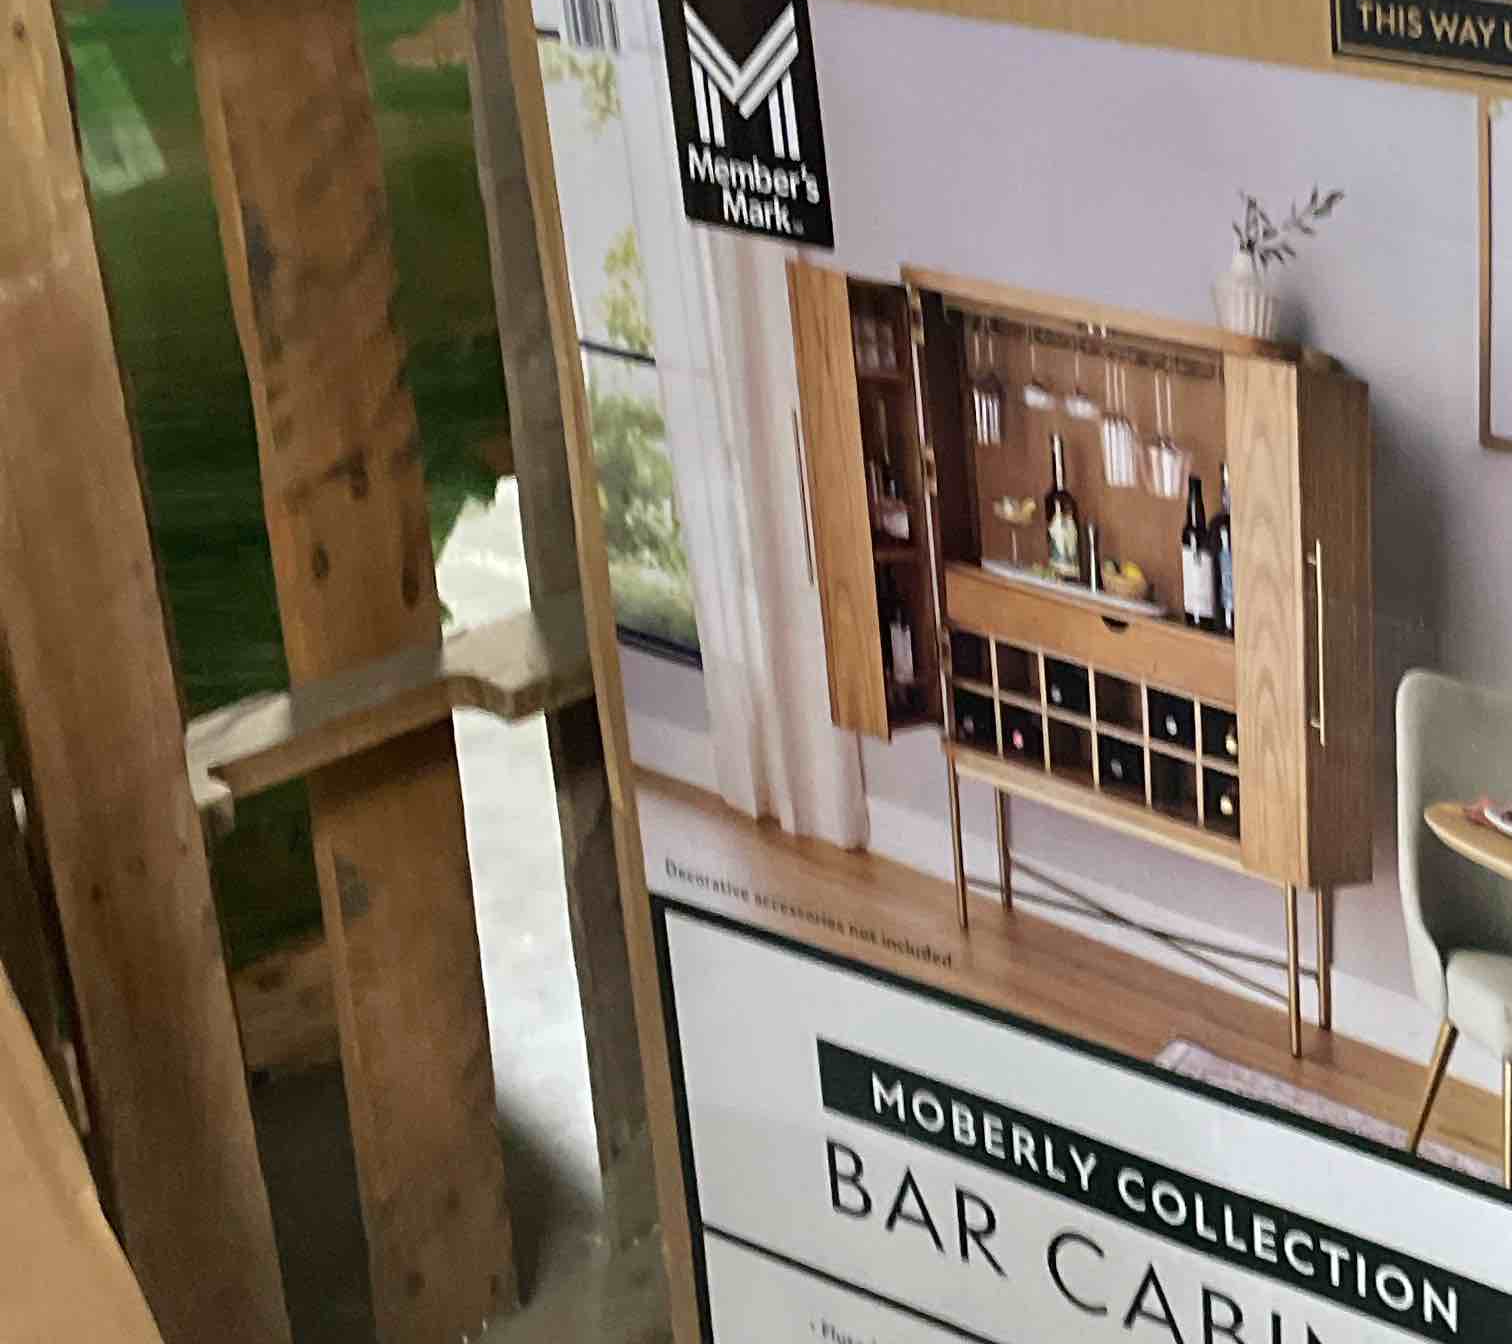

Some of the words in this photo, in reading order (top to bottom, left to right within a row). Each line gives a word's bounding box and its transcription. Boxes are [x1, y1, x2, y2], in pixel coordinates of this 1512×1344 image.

[1357, 0, 1423, 41] THIS
[1429, 15, 1496, 48] WAY
[688, 142, 820, 205] Member's
[826, 1137, 1007, 1278] BAR
[871, 1071, 1097, 1191] MOBERLY
[1117, 1167, 1459, 1333] COLLECTION
